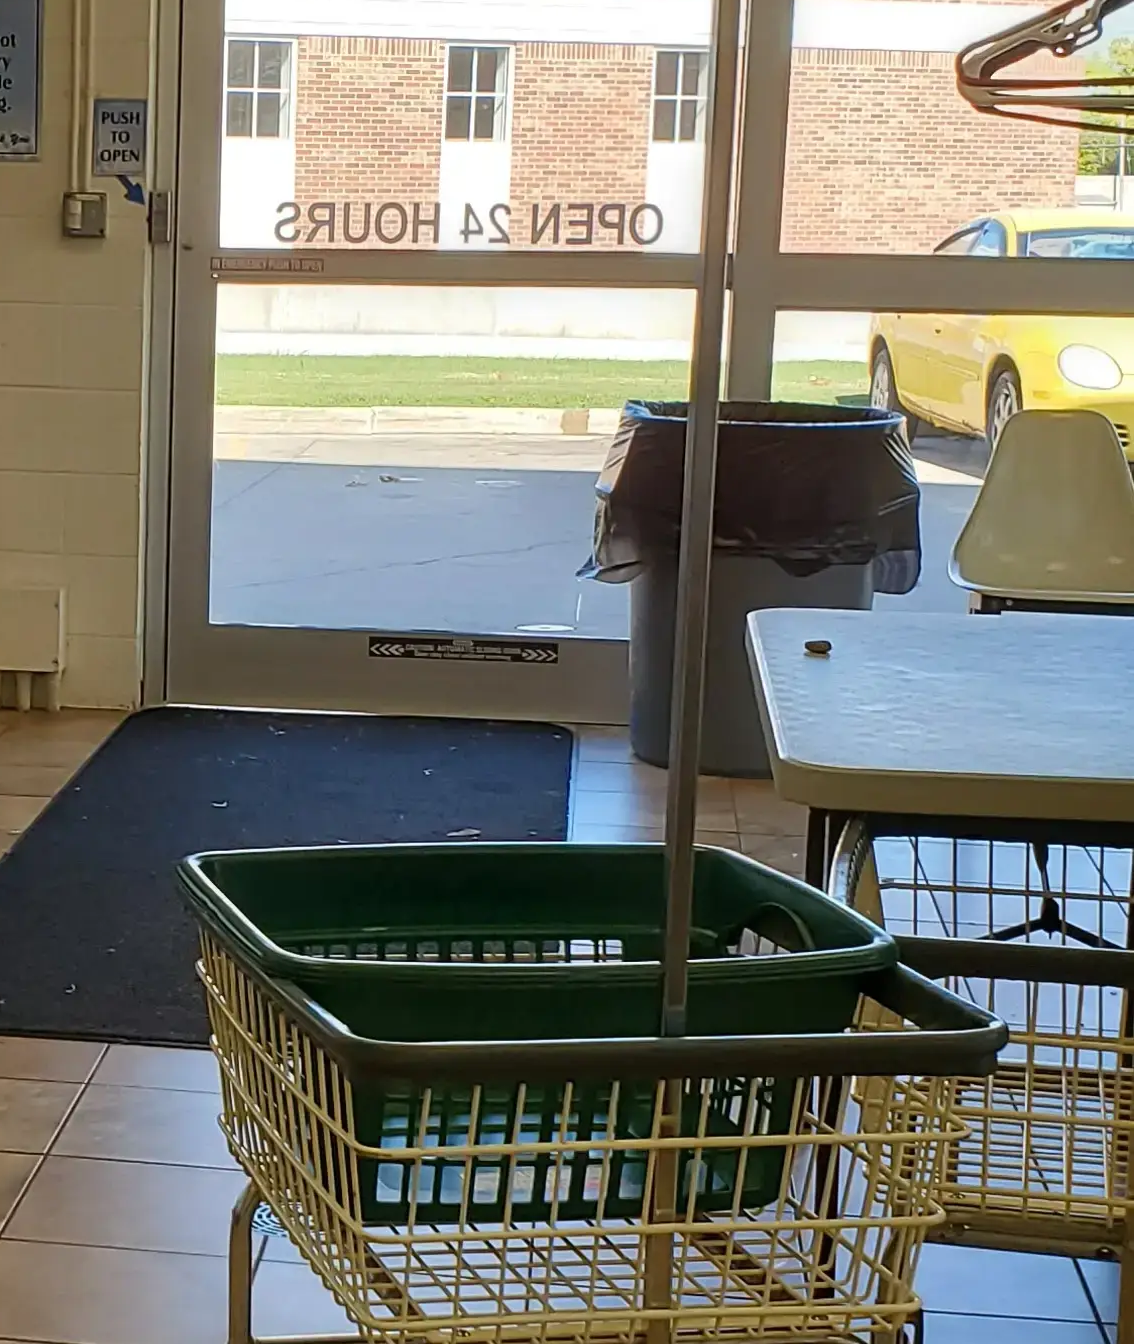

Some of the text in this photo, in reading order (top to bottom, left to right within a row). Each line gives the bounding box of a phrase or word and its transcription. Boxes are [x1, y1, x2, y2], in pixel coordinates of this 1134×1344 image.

[101, 111, 141, 125] PUSH
[10, 134, 30, 146] You
[110, 131, 131, 144] TO
[99, 149, 141, 163] OPEN
